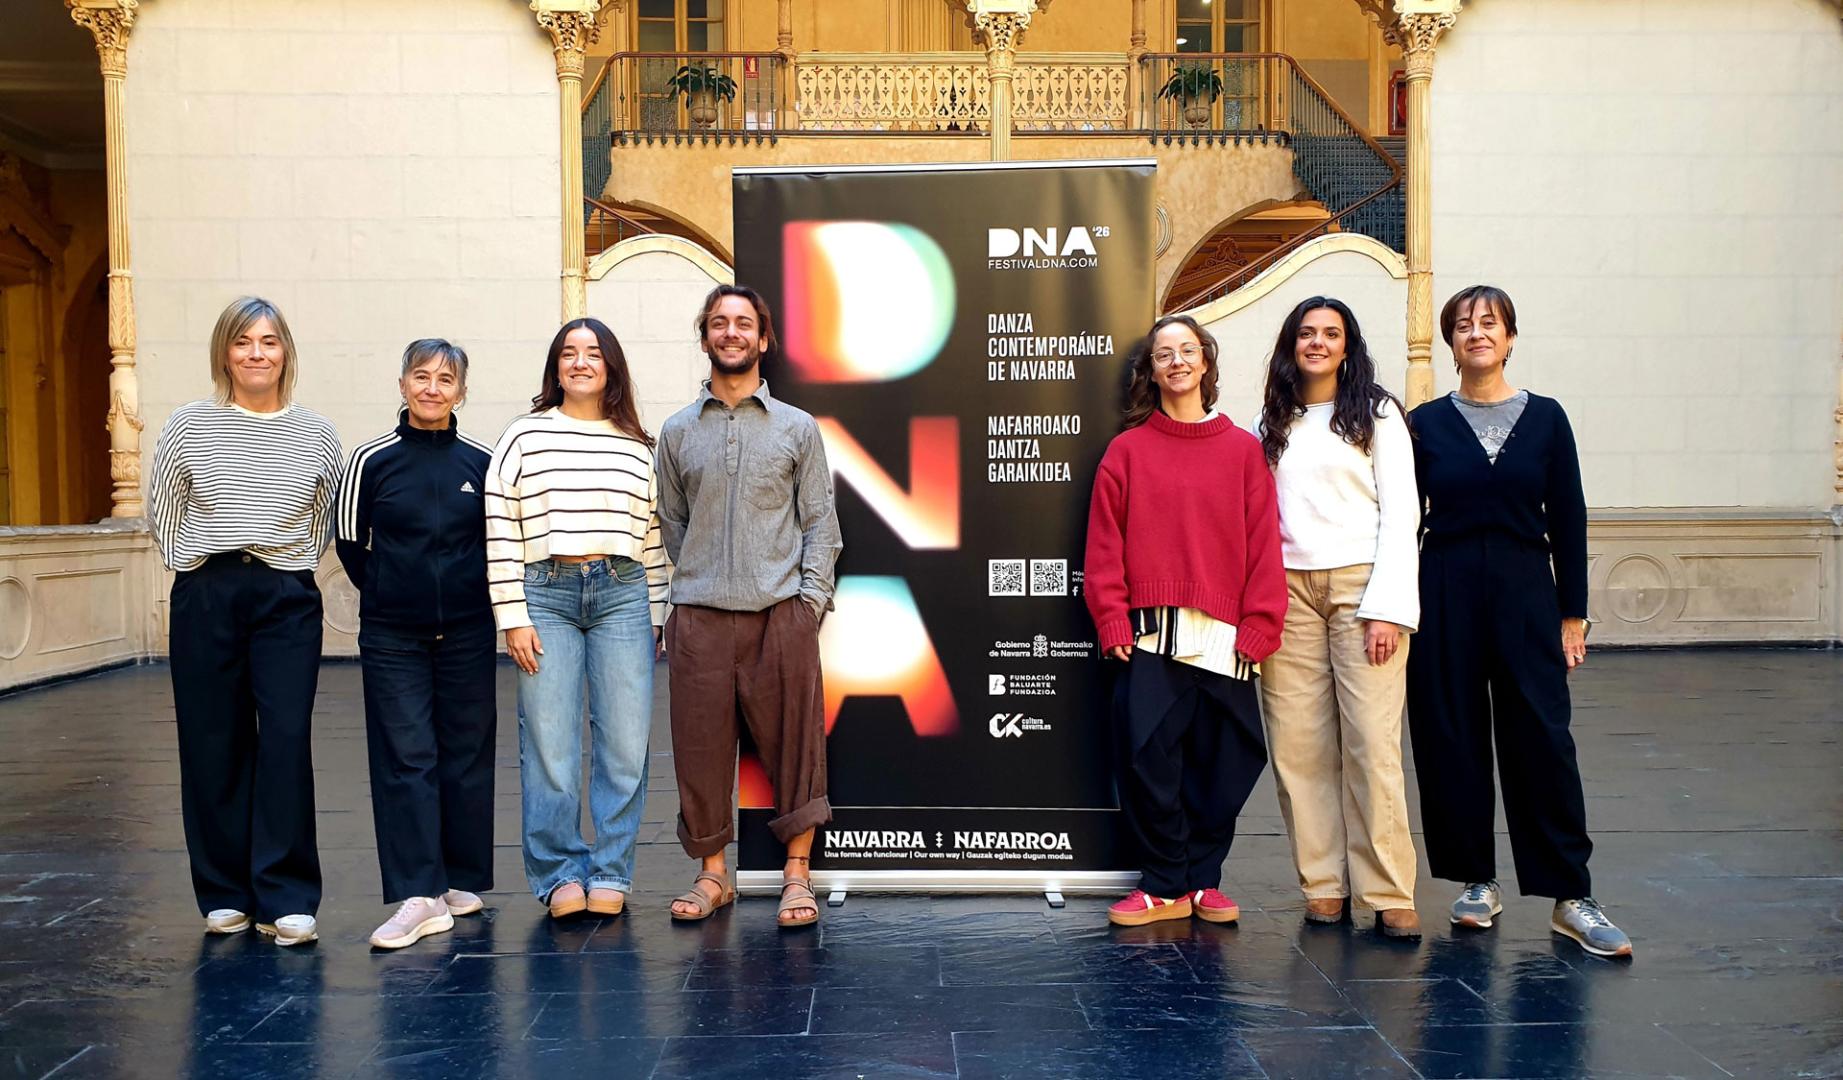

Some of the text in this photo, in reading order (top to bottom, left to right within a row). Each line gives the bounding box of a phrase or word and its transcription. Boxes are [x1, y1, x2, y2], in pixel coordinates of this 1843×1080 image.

[988, 226, 1097, 257] DNA
[988, 258, 1098, 269] FESTIVALDNA.COM
[989, 313, 1033, 333] DANZA
[988, 331, 1114, 357] CONTEMPORÁNEA
[988, 360, 1075, 380] DE NAVARRA
[989, 415, 1080, 435] NAFARROAKO
[988, 439, 1040, 459] DANTZA
[989, 462, 1071, 482] GARAIKIDEA
[1022, 717, 1043, 725] cultura
[825, 831, 1072, 849] NAVARRA NAFARROA
[994, 852, 1021, 860] egiteko
